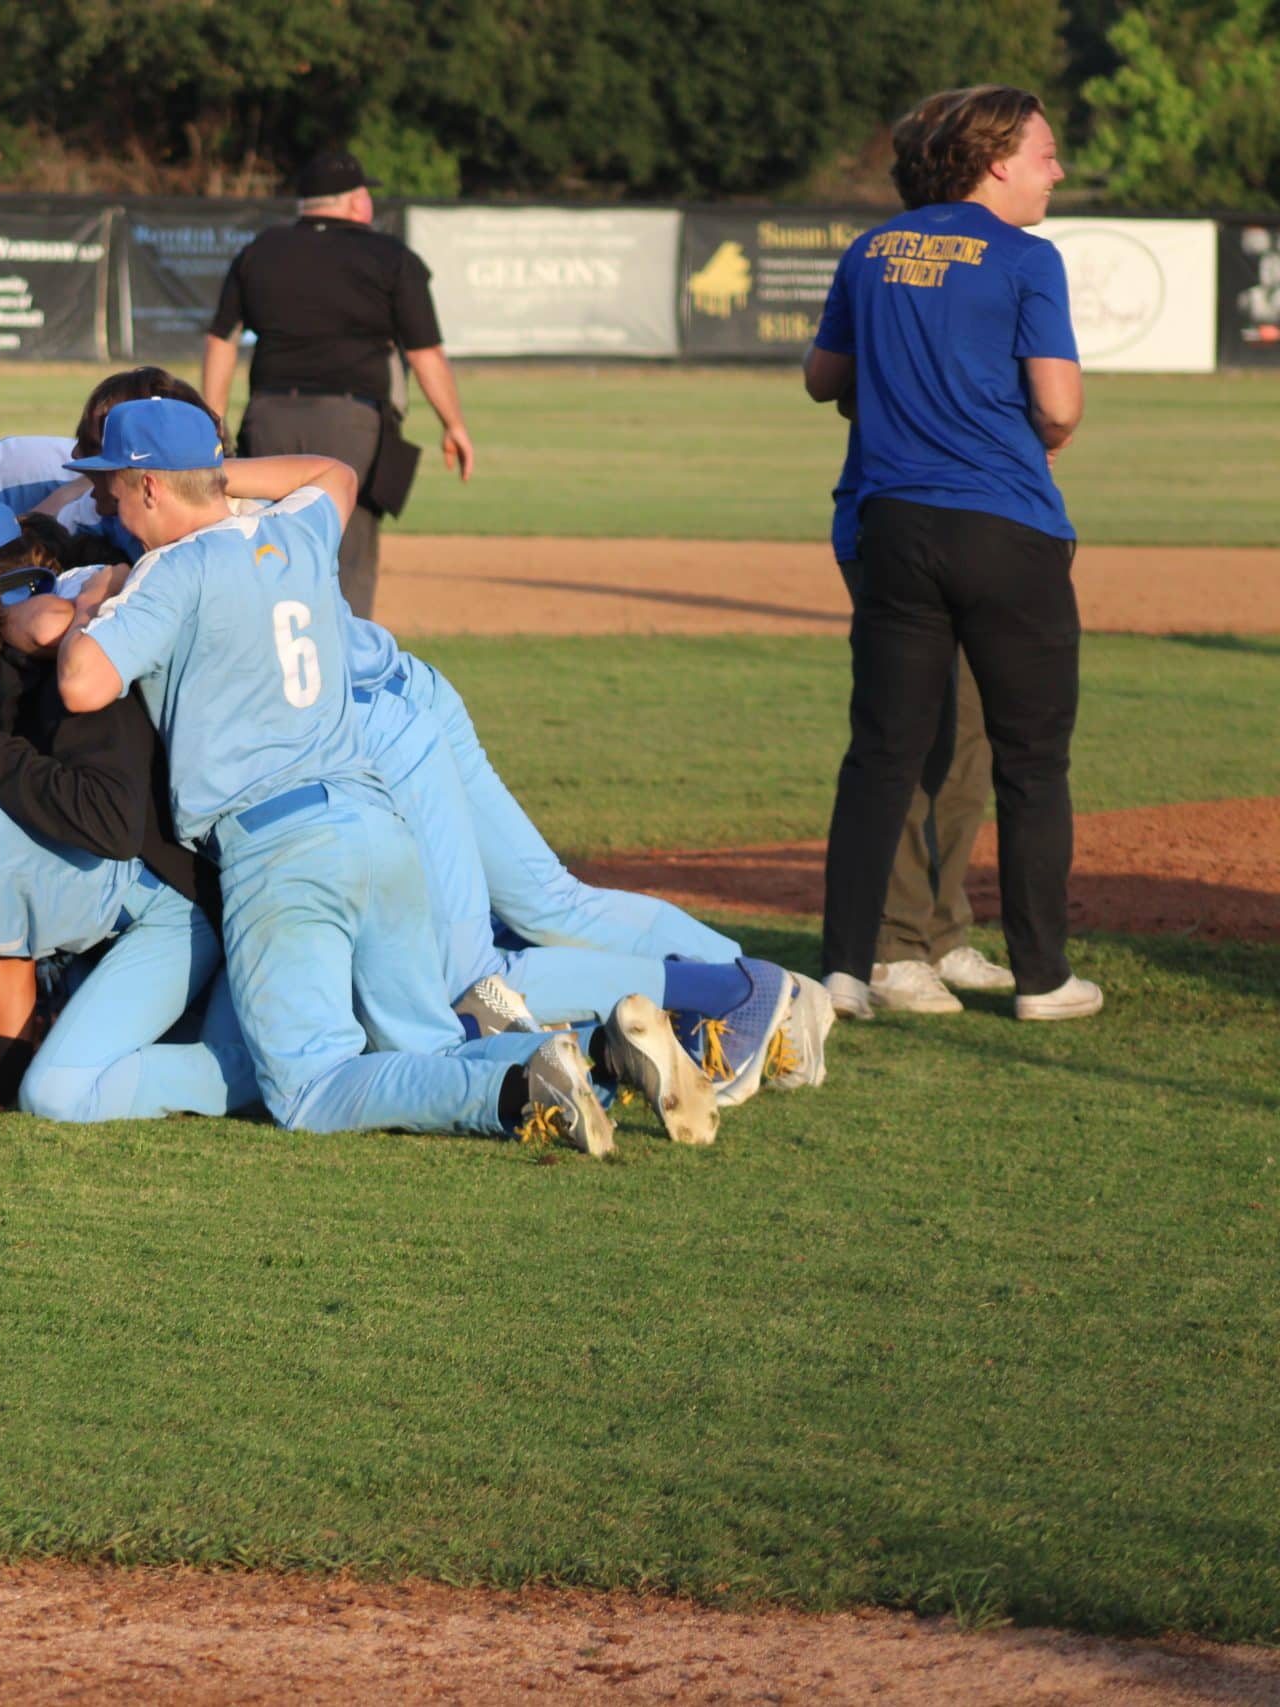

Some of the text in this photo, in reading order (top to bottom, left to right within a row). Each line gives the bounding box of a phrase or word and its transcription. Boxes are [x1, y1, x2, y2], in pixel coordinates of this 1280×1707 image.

[758, 222, 827, 248] Susan
[864, 231, 989, 266] SPORTS MEDICINE
[467, 256, 622, 287] GELSON'S
[883, 256, 951, 287] STUDENT
[272, 600, 322, 709] 6
